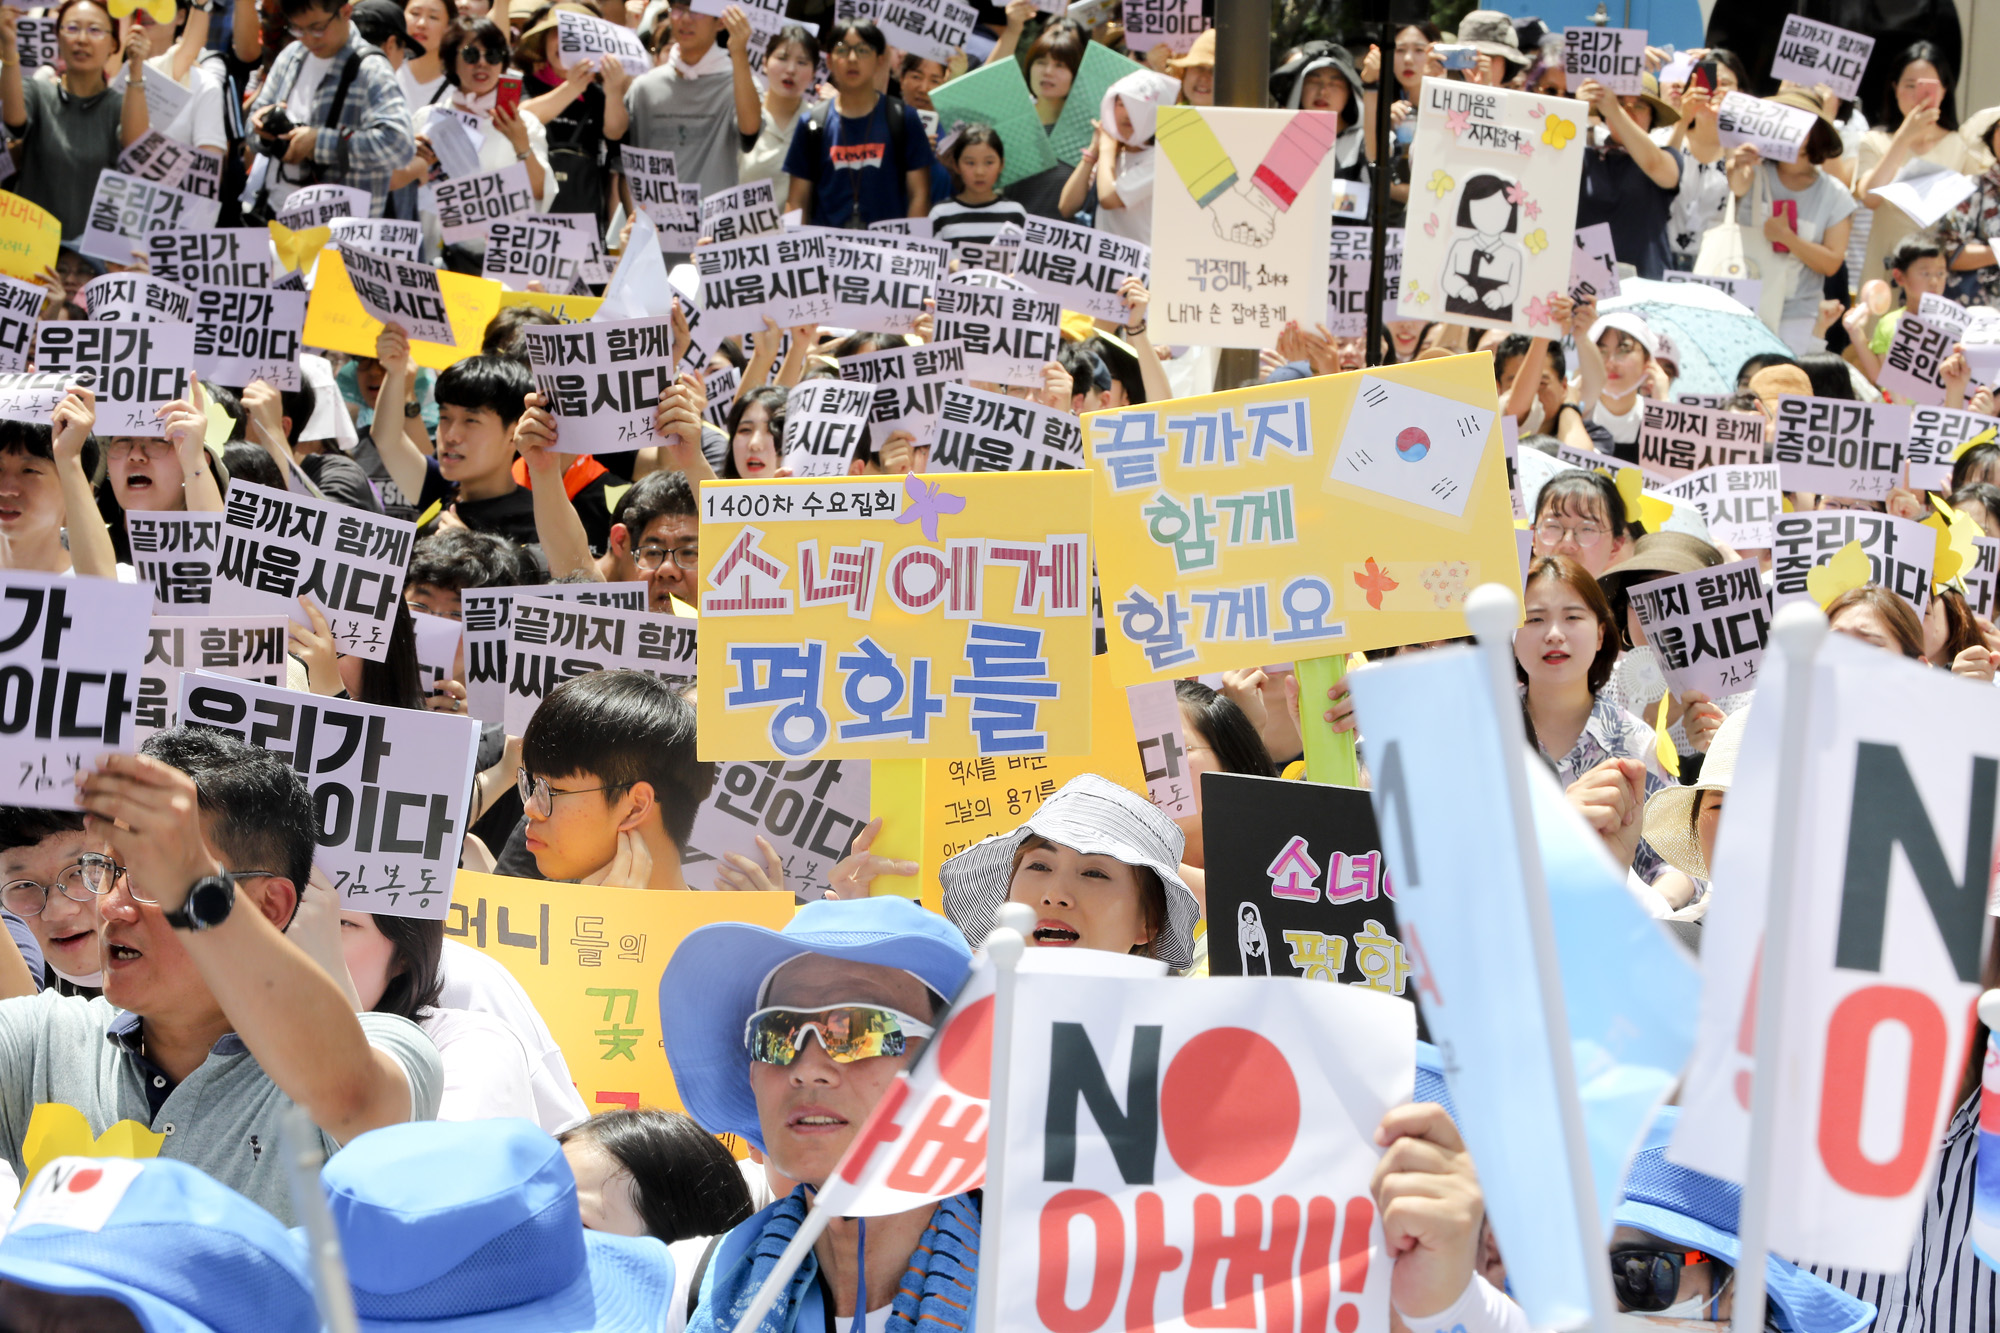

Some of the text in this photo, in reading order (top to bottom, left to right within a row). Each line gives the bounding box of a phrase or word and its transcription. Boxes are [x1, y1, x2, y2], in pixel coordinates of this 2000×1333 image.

[559, 13, 618, 37] 우리가
[883, 8, 967, 48] 싸웁시다
[942, 2, 976, 28] 함께
[560, 30, 644, 58] 증인이다
[1565, 31, 1623, 54] 우리가
[1784, 18, 1871, 58] 끝까지 함께
[1565, 52, 1643, 77] 증인이다
[1778, 39, 1863, 82] 싸웁시다
[1432, 88, 1496, 120] 내 마음은
[1718, 107, 1802, 144] 증인이다
[648, 156, 676, 176] 함께
[99, 175, 185, 222] 우리가
[436, 173, 504, 205] 우리가
[703, 182, 773, 220] 끝까지 함께
[439, 189, 532, 229] 증인이다
[704, 207, 780, 242] 싸웁시다
[150, 231, 240, 264] 우리가
[380, 224, 418, 246] 함께
[489, 223, 561, 253] 우리가
[698, 241, 771, 276] 끝까지
[777, 233, 827, 265] 함께
[1026, 220, 1141, 269] 끝까지 함께
[396, 265, 440, 293] 함께
[486, 248, 580, 281] 증인이다
[890, 255, 937, 281] 함께
[1017, 247, 1131, 296] 싸웁시다
[1186, 258, 1253, 293] 걱정마,
[145, 279, 190, 320] 함께
[704, 264, 834, 310] 싸웁시다
[197, 290, 274, 326] 우리가
[937, 287, 1062, 327] 끝까지 함께
[1167, 302, 1288, 328] 내가 손 잡아줄게
[39, 326, 153, 365] 우리가
[193, 324, 300, 363] 증인이다
[525, 331, 597, 367] 끝까지
[606, 324, 671, 360] 함께
[935, 318, 1056, 362] 싸웁시다
[841, 345, 966, 385] 끝까지 함께
[536, 365, 672, 418] 싸웁시다
[820, 386, 872, 418] 함께
[942, 389, 1037, 439] 끝까지
[1645, 404, 1763, 445] 끝까지 함께
[1780, 400, 1874, 438] 우리가
[1094, 400, 1310, 490] 끝까지
[1774, 434, 1904, 473] 증인이다
[1726, 470, 1778, 491] 함께
[706, 489, 897, 518] 1400차 수요집회
[131, 519, 221, 553] 끝까지
[225, 487, 328, 547] 끝까지
[336, 515, 413, 568] 함께
[1143, 487, 1295, 572] 함께
[1776, 517, 1898, 556] 우리가
[217, 536, 399, 622] 싸웁시다
[703, 530, 1081, 614] 소녀에게
[1631, 567, 1762, 627] 끝까지 함께
[513, 604, 626, 656] 끝까지
[1116, 575, 1344, 672] 할께요
[1646, 605, 1772, 671] 싸웁시다
[200, 626, 285, 668] 함께
[726, 622, 1059, 756] 평화를
[948, 756, 997, 786] 역사를
[944, 797, 992, 826] 그날의
[335, 865, 444, 910] 김복동
[584, 987, 645, 1062] 꽃
